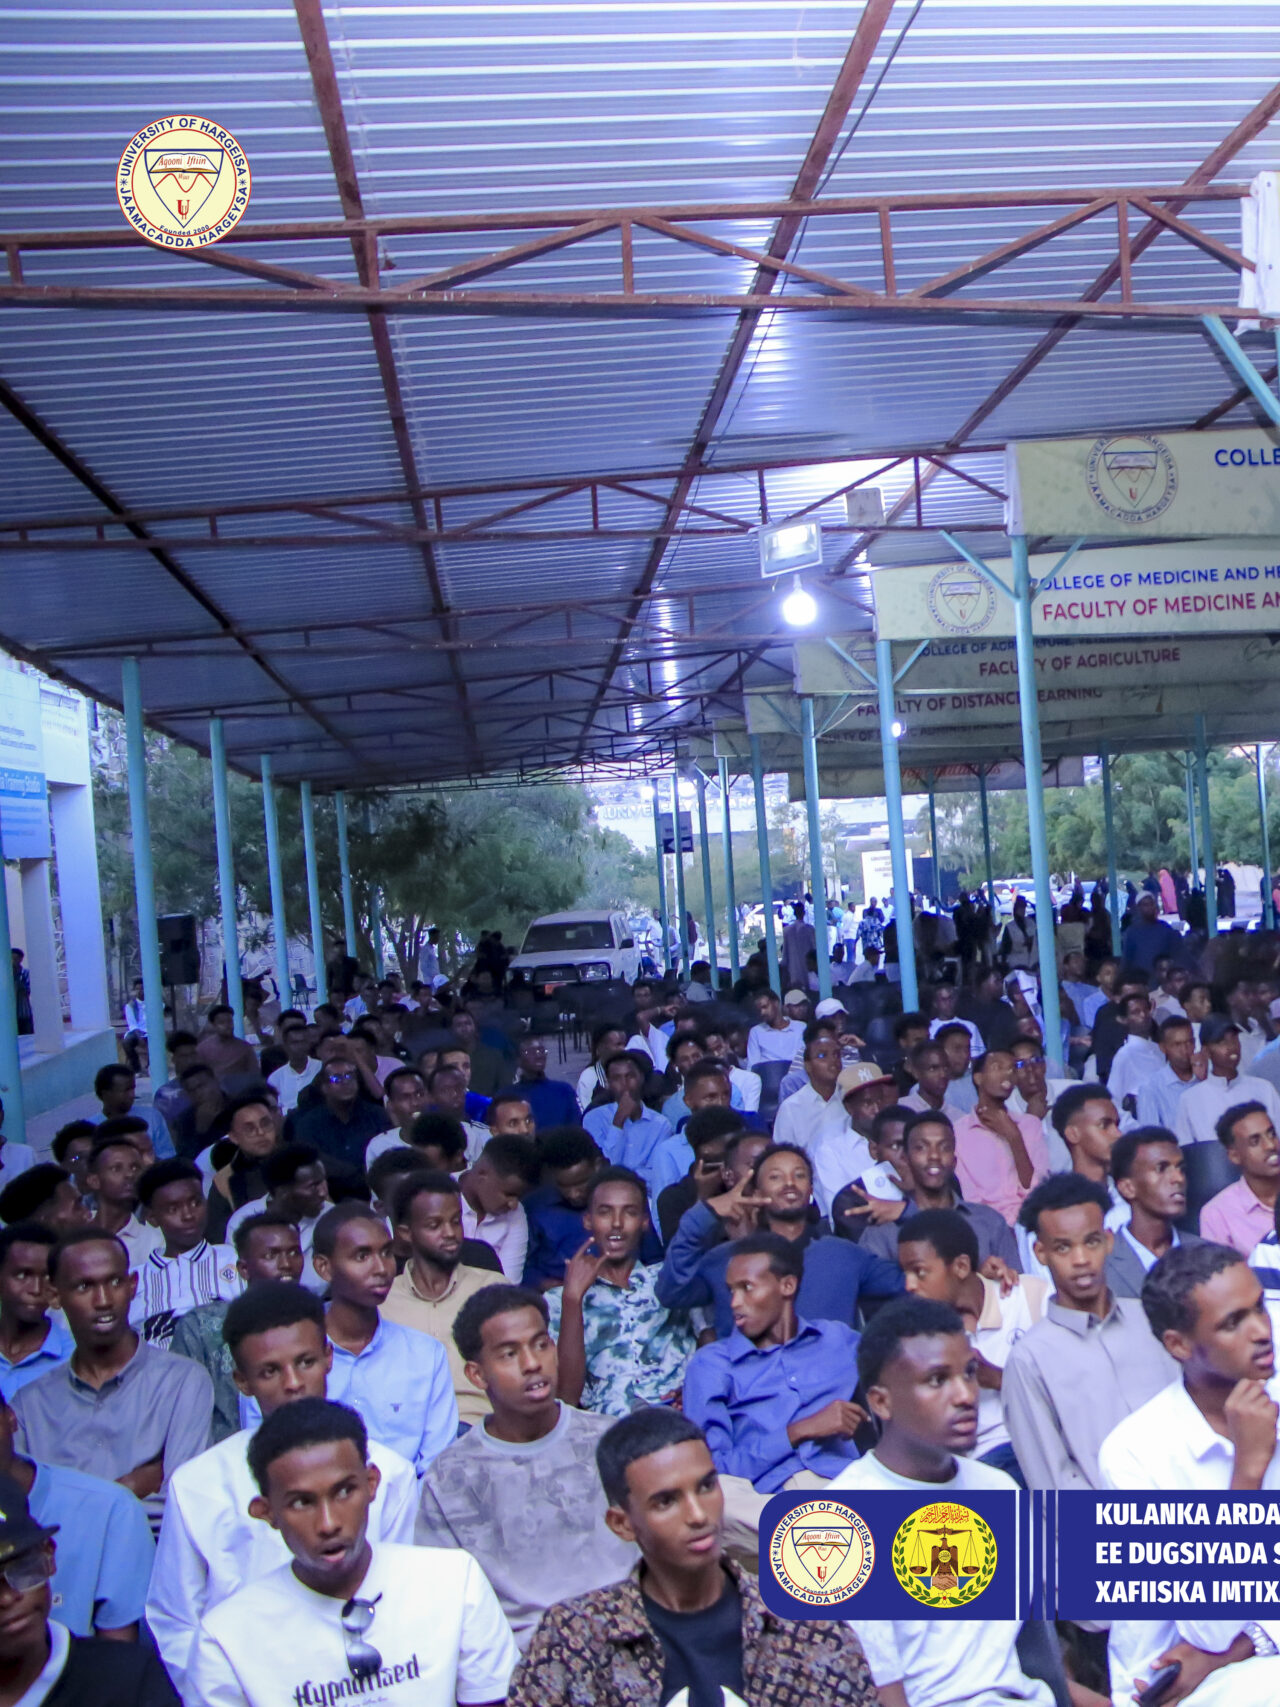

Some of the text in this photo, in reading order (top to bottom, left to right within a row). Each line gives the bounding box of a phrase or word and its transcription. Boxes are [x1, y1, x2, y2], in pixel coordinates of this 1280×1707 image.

[1110, 572, 1133, 588] OF
[1137, 568, 1219, 587] MEDICINE
[1224, 566, 1260, 582] AND
[1042, 599, 1127, 621] FACULTY
[1132, 598, 1159, 616] OF
[1164, 592, 1257, 614] MEDICINE
[971, 640, 990, 654] OF
[1051, 657, 1072, 672] OF
[1077, 647, 1181, 669] AGRICULTURE
[927, 697, 947, 712] OF
